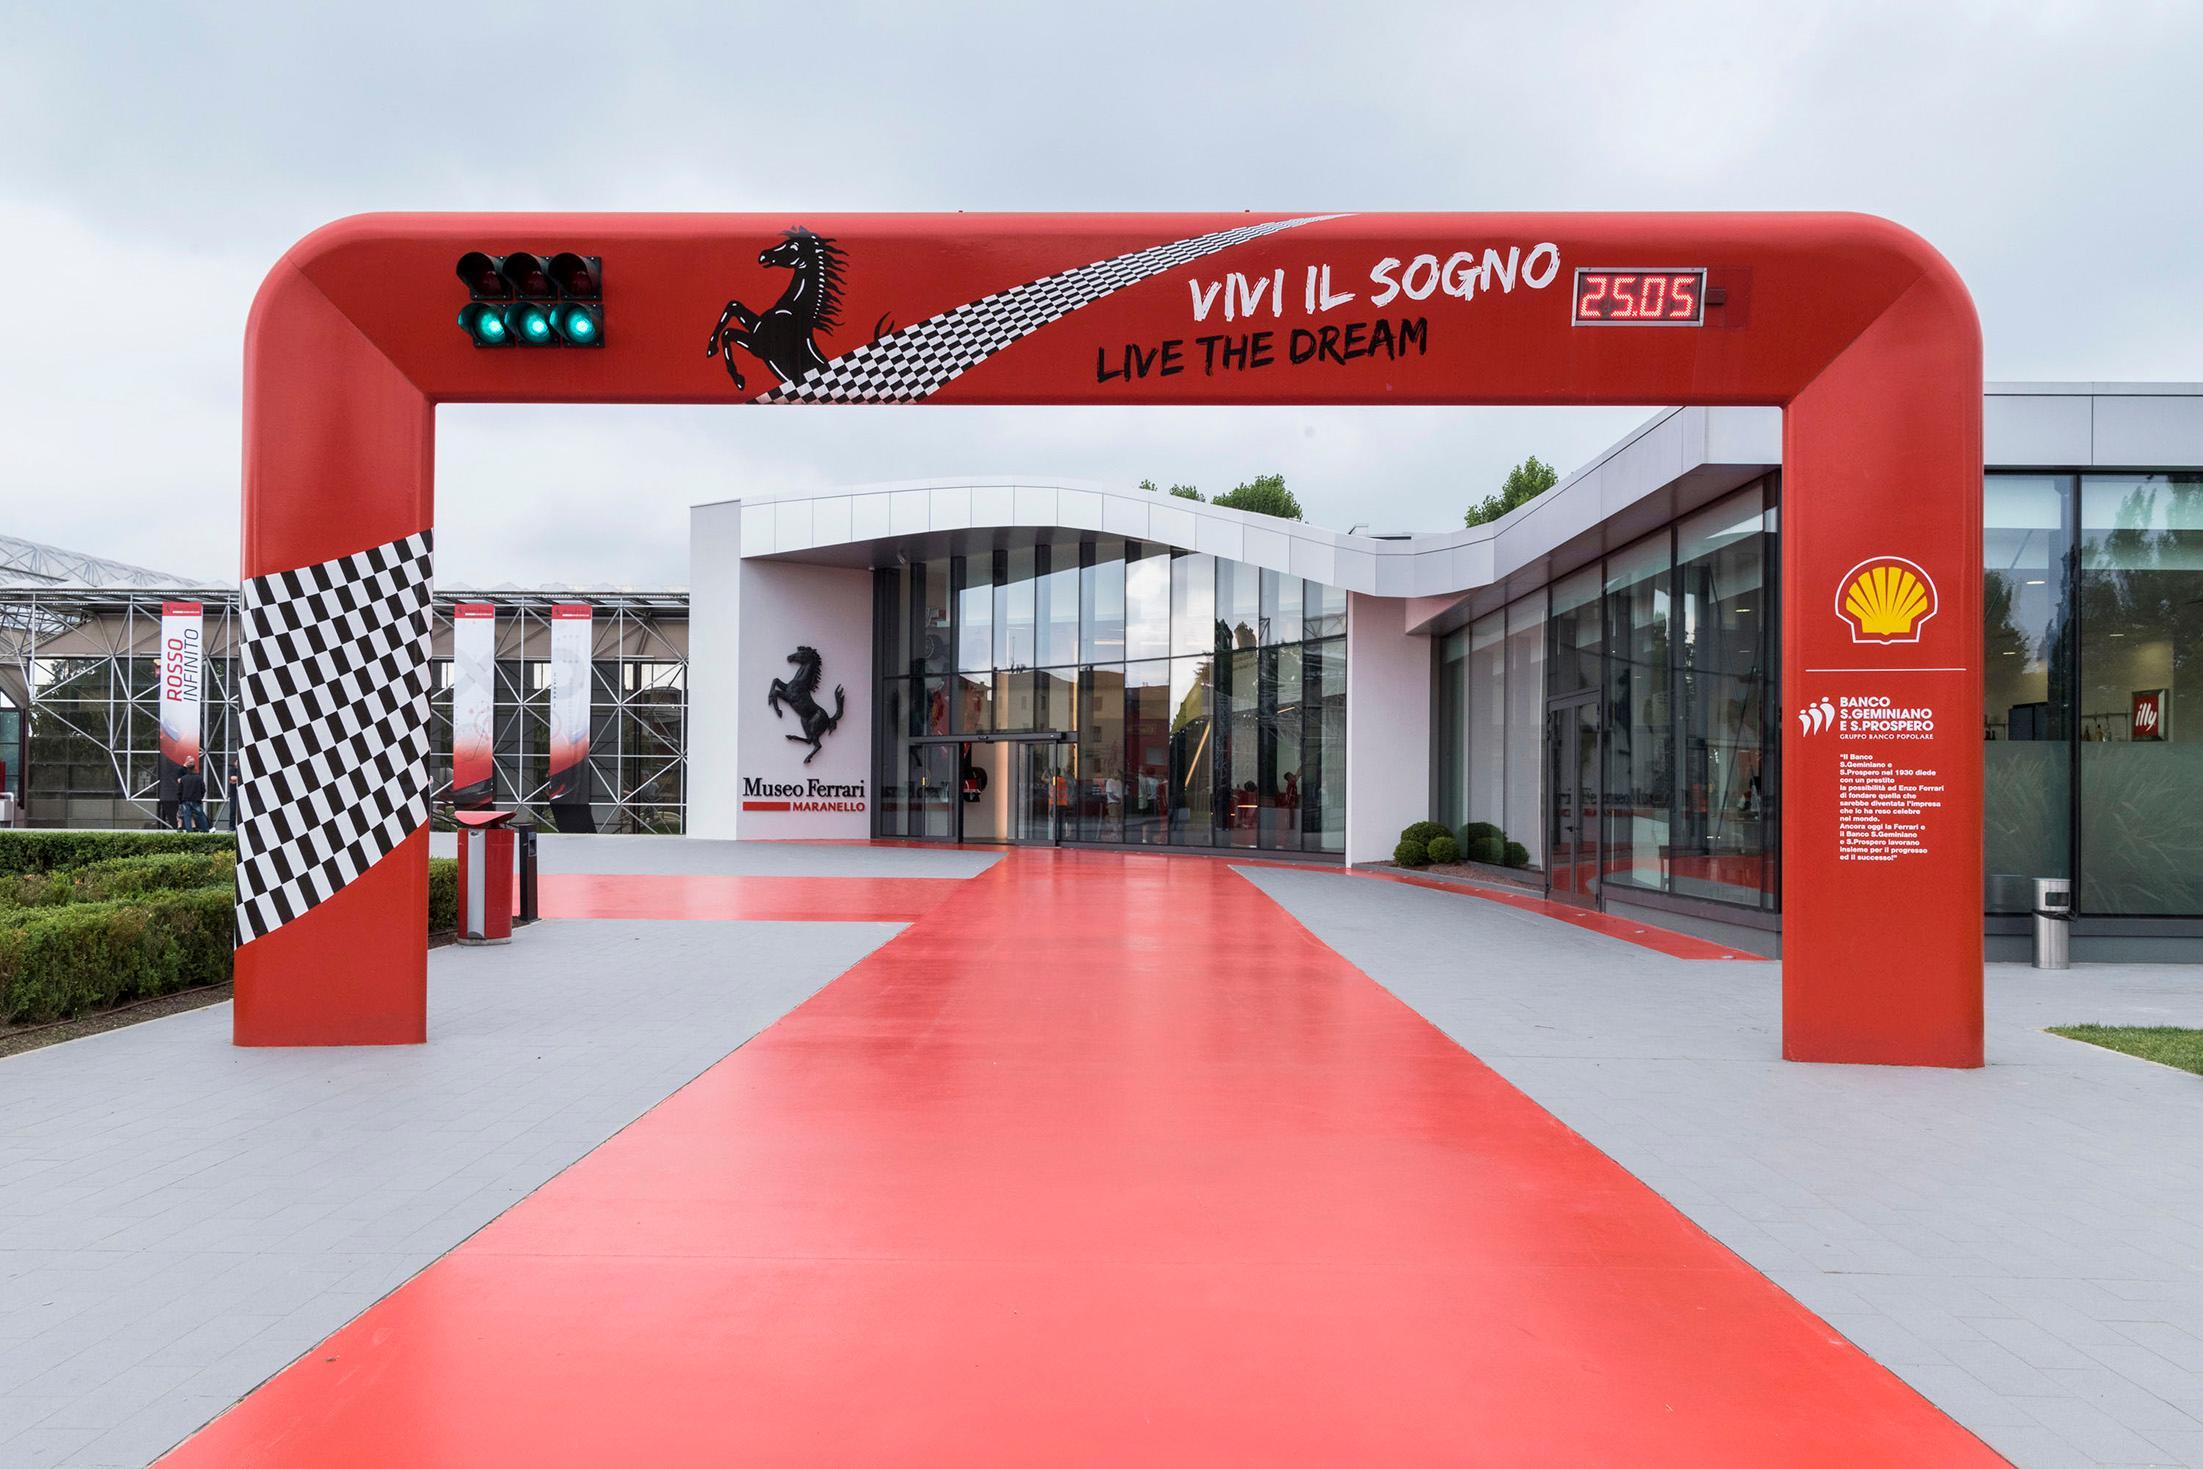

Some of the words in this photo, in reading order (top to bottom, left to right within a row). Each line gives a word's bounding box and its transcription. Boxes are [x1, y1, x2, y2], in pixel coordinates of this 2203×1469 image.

[1188, 268, 1285, 322] VIVI
[1305, 264, 1356, 315] IL
[1370, 242, 1561, 308] SOGNO
[1580, 277, 1696, 317] 25.05
[1097, 339, 1184, 383] LIVE
[1195, 331, 1275, 376] THE
[1289, 317, 1428, 366] DREAM
[167, 638, 183, 702] ROSSO
[183, 628, 199, 702] INFINITO
[1840, 696, 1891, 707] BANCO
[1840, 708, 1933, 719] S.GEMINIANO
[1840, 721, 1847, 731] E
[1850, 720, 1934, 731] S.PROSPERO
[2135, 702, 2157, 732] illy
[742, 777, 804, 797] Museo
[806, 778, 865, 798] Ferrari
[793, 802, 865, 812] MARANELLO
